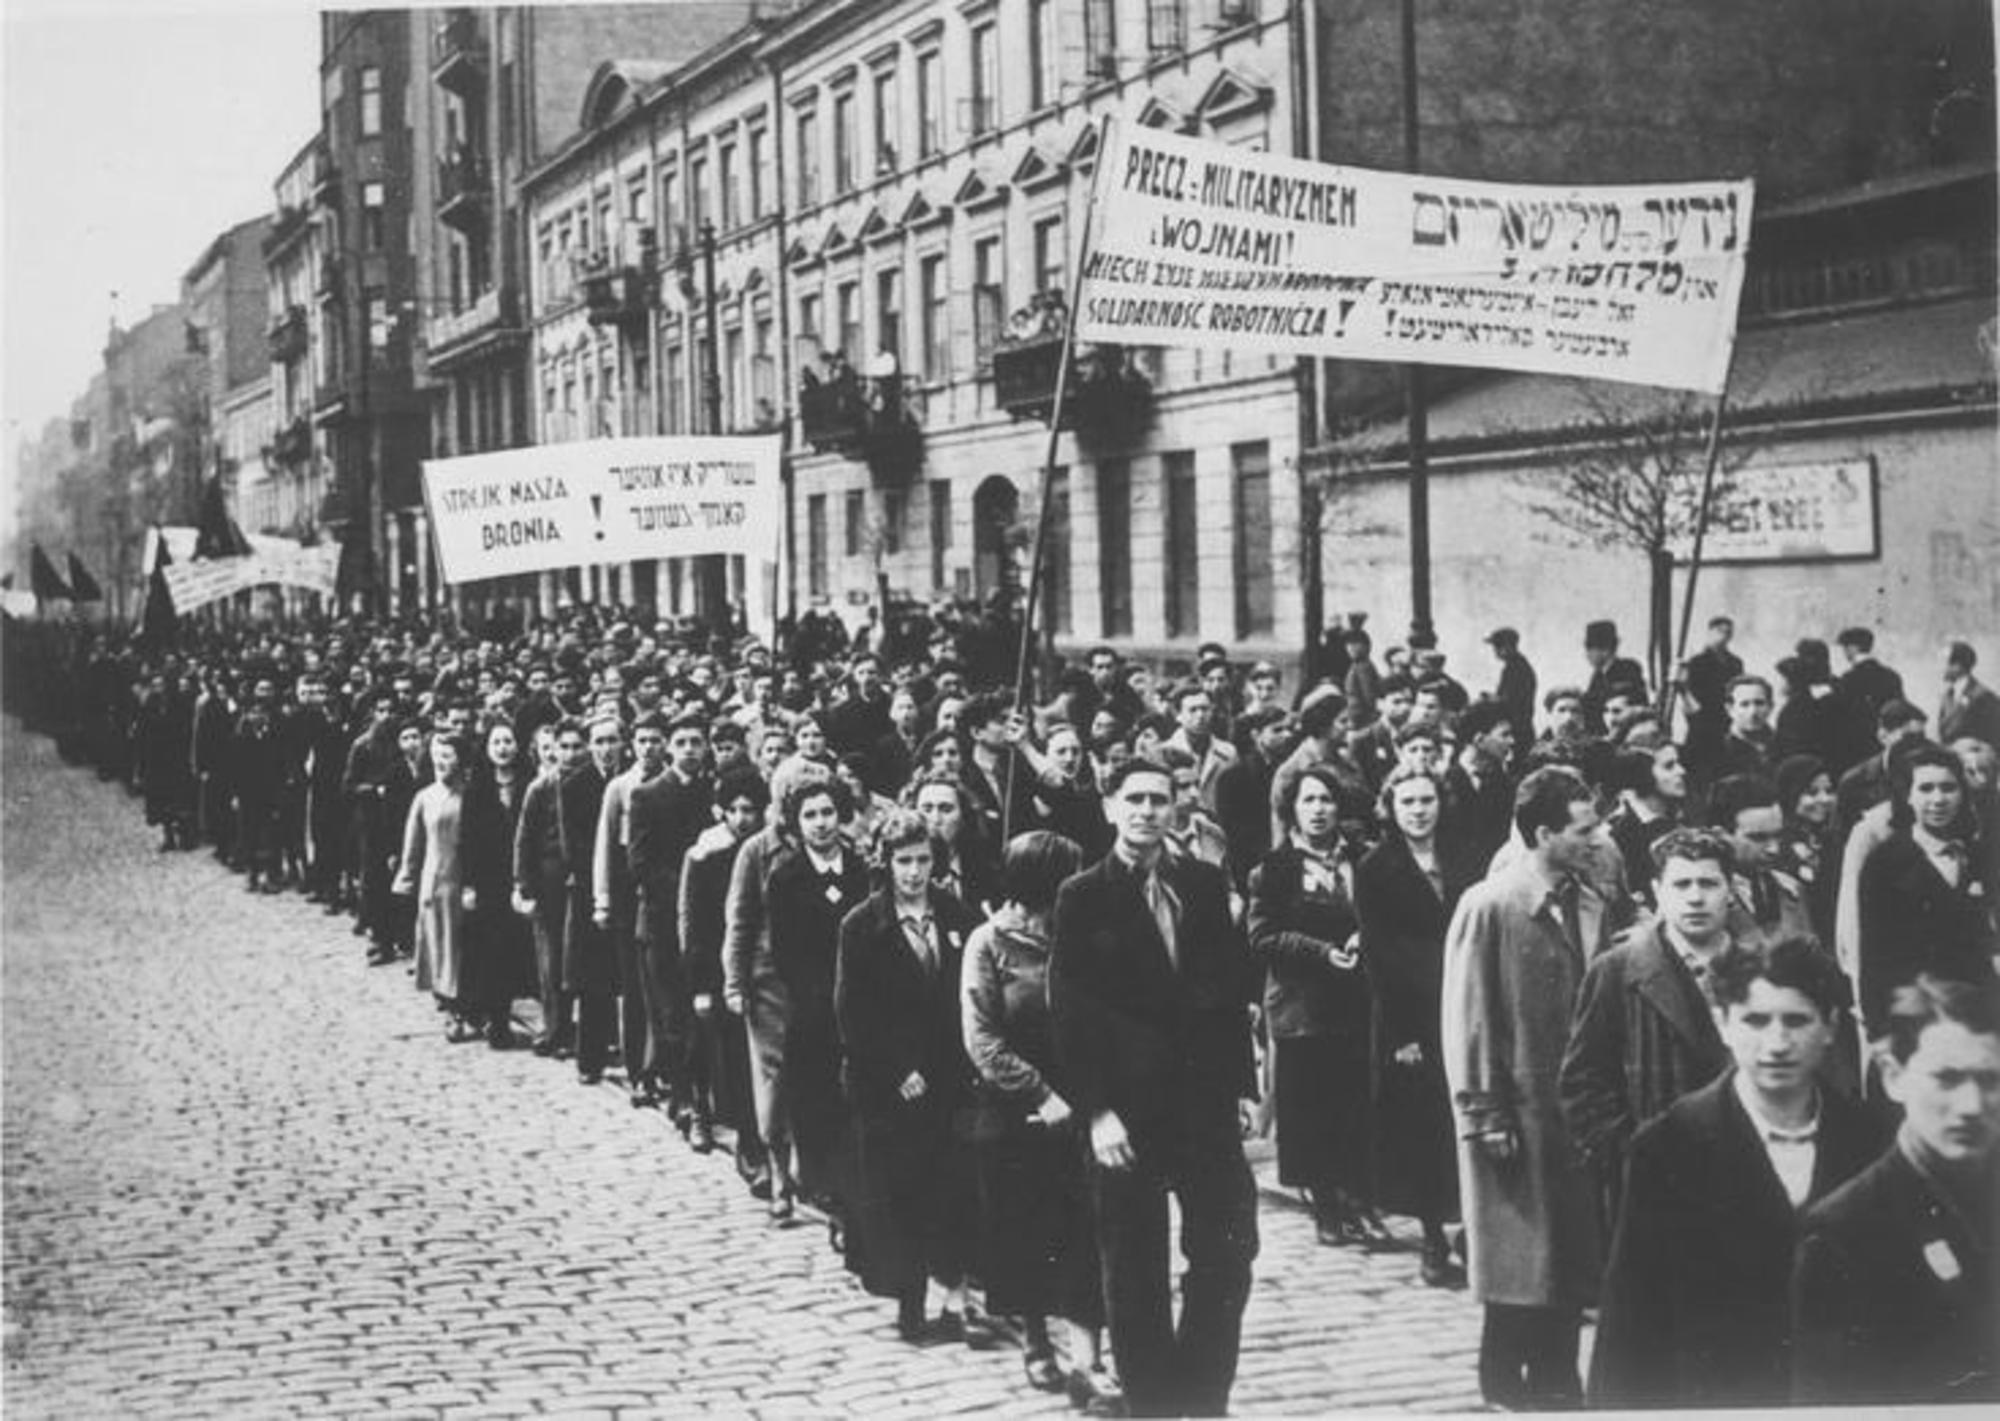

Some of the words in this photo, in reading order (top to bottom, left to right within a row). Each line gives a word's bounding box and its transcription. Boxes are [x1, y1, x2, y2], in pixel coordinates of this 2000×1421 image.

[1123, 145, 1187, 200] PRECZ
[1202, 163, 1357, 227] MILITARYZMEM
[1085, 250, 1149, 284] NIECH
[482, 517, 561, 551] BRONIA
